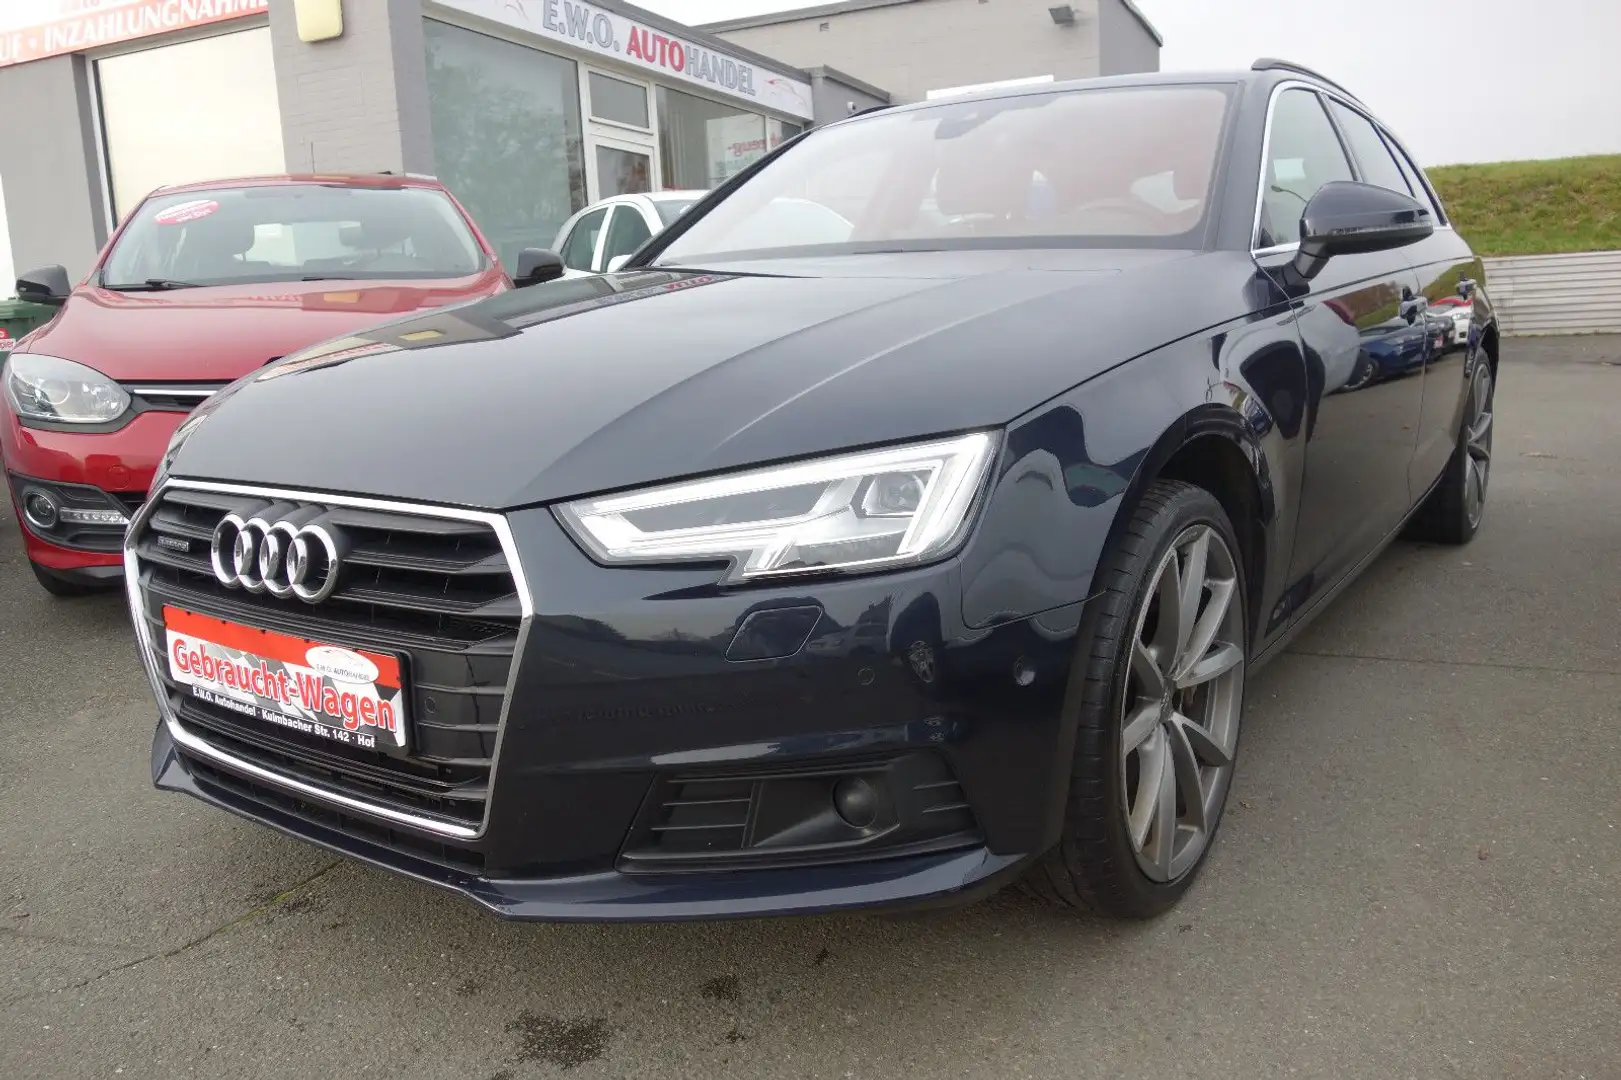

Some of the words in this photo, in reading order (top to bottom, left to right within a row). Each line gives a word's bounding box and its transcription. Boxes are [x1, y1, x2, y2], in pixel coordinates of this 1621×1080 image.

[542, 0, 621, 52] E.W.O.
[626, 25, 757, 96] AUTOHANDEL
[172, 638, 398, 733] Gebraucht-Wagen
[192, 687, 214, 702] E.W.O.
[214, 696, 257, 717] Autohandel
[261, 709, 312, 734] Kulmbacher
[314, 724, 331, 738] Str.
[332, 729, 350, 743] 142
[357, 735, 376, 749] Hof
